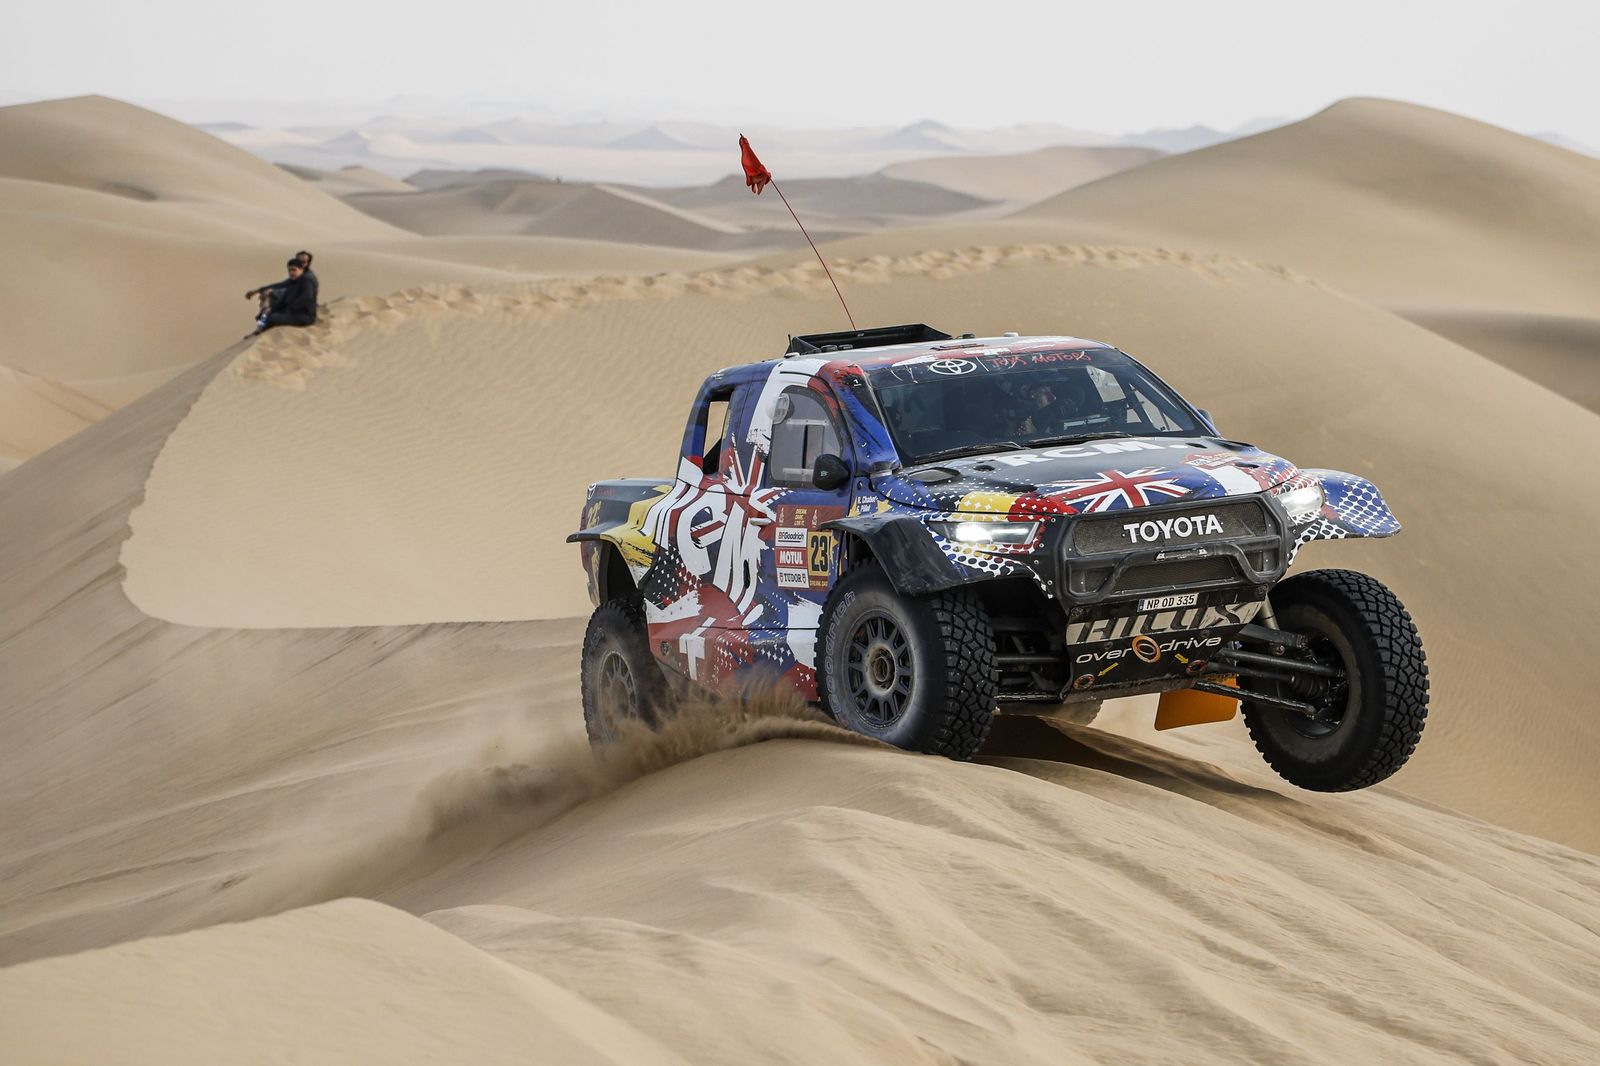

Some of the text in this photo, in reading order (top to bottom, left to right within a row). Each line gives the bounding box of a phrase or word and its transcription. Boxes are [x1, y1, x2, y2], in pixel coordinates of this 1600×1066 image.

[1123, 514, 1224, 543] TOYOTA
[778, 531, 805, 540] BFGoodrich
[779, 550, 804, 565] MOTUL
[783, 573, 803, 583] TUDOR
[1162, 597, 1175, 608] OD
[1177, 595, 1195, 606] 335
